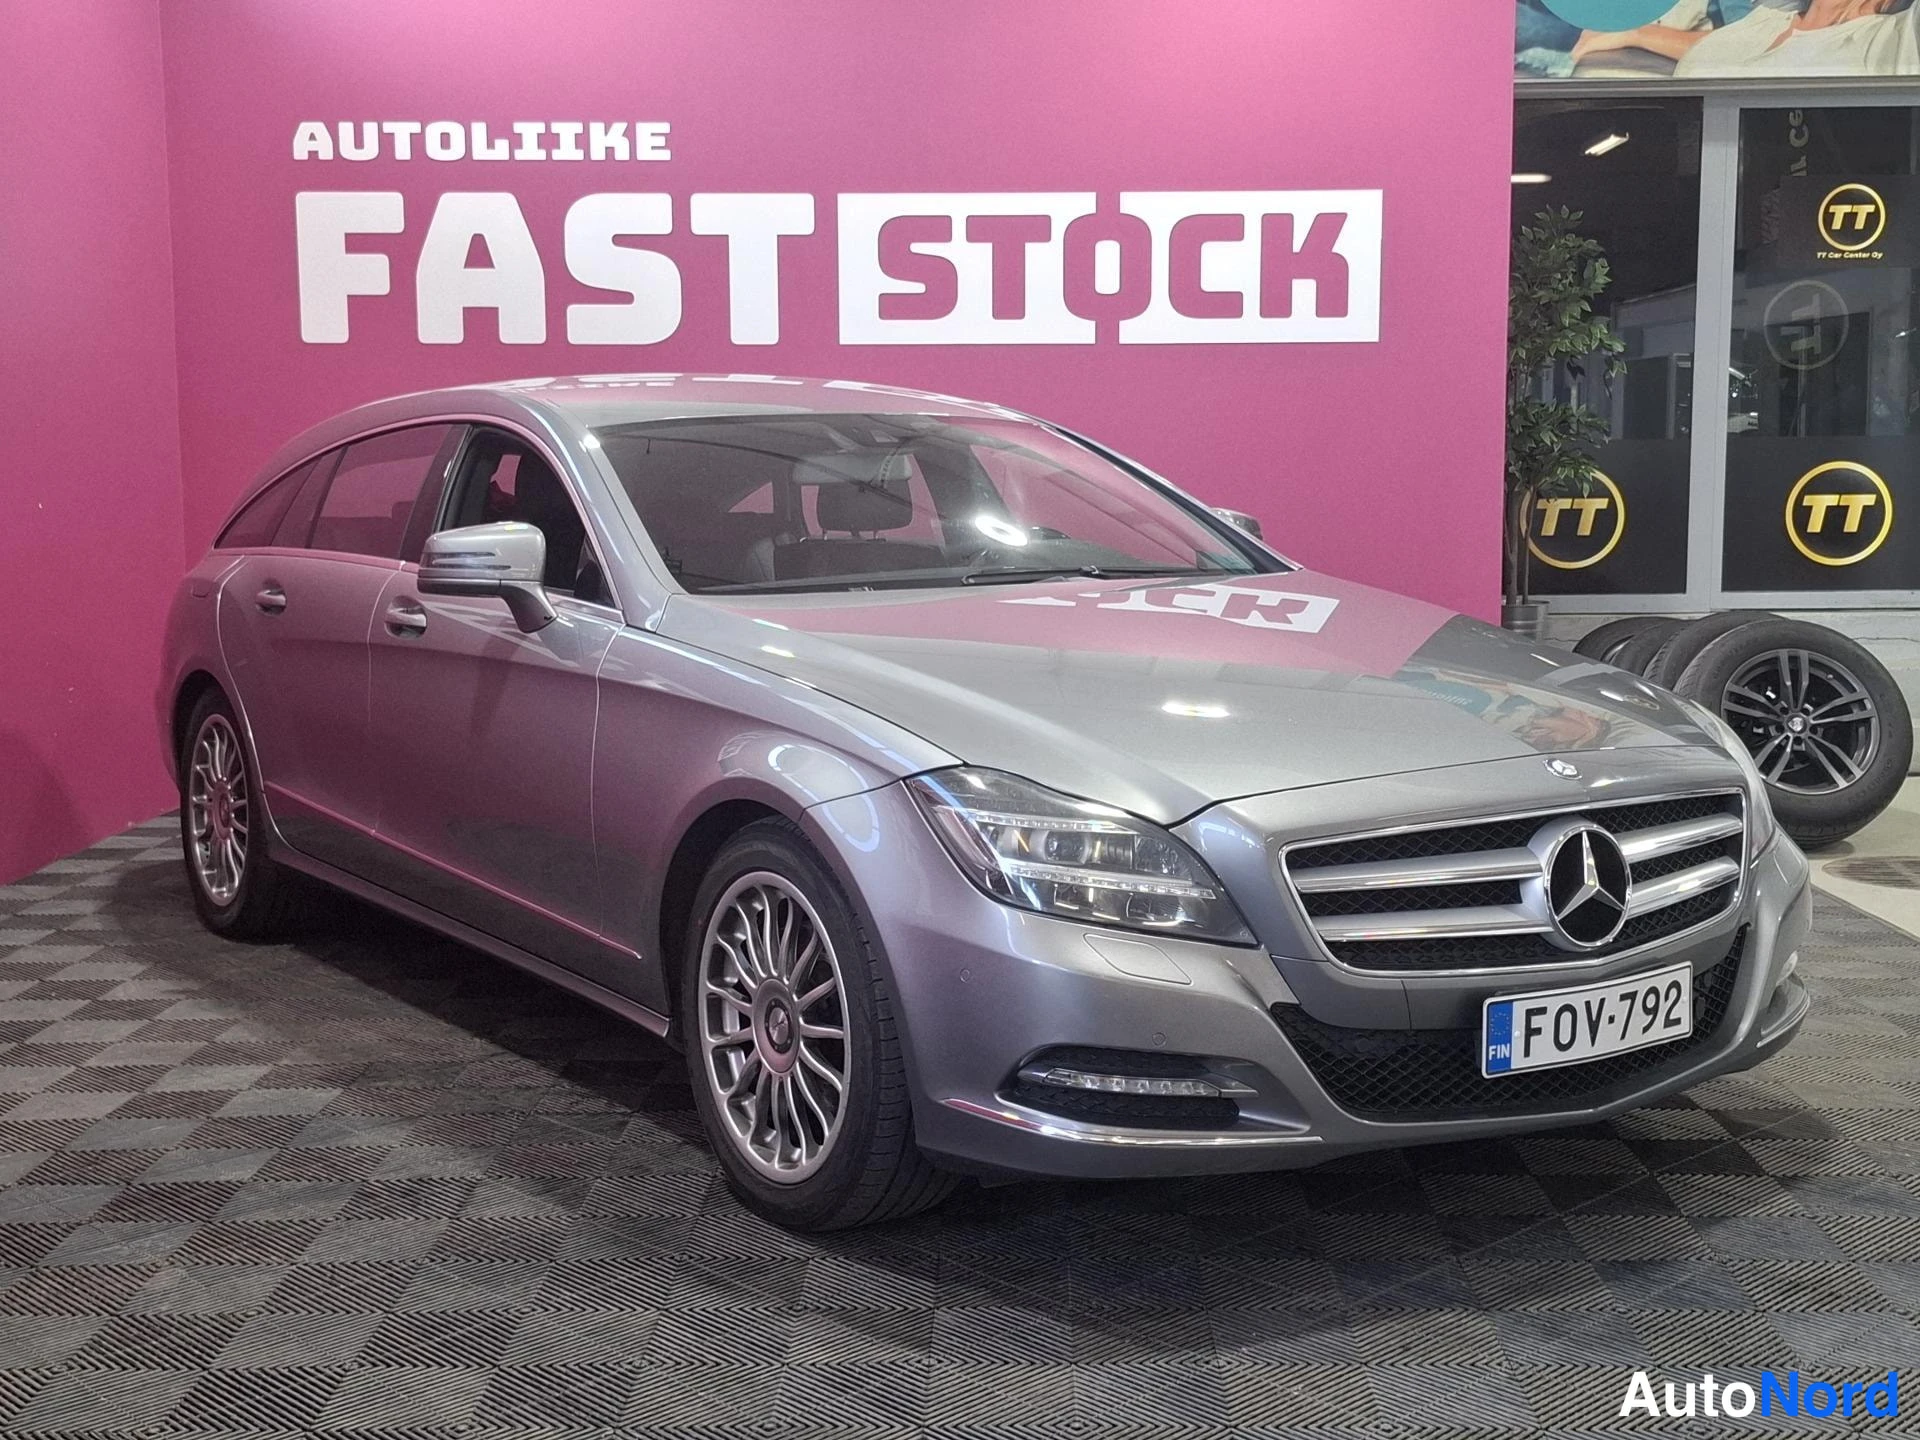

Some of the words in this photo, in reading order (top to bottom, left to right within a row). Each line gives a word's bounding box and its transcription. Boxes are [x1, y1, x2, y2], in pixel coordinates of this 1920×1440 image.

[293, 121, 671, 161] AUTOLIIKE
[1829, 204, 1876, 230] TT
[1843, 251, 1870, 259] Center
[1871, 251, 1883, 259] Oy
[1536, 498, 1609, 537] TT
[1802, 494, 1877, 533] TT
[1488, 1043, 1511, 1061] FIN
